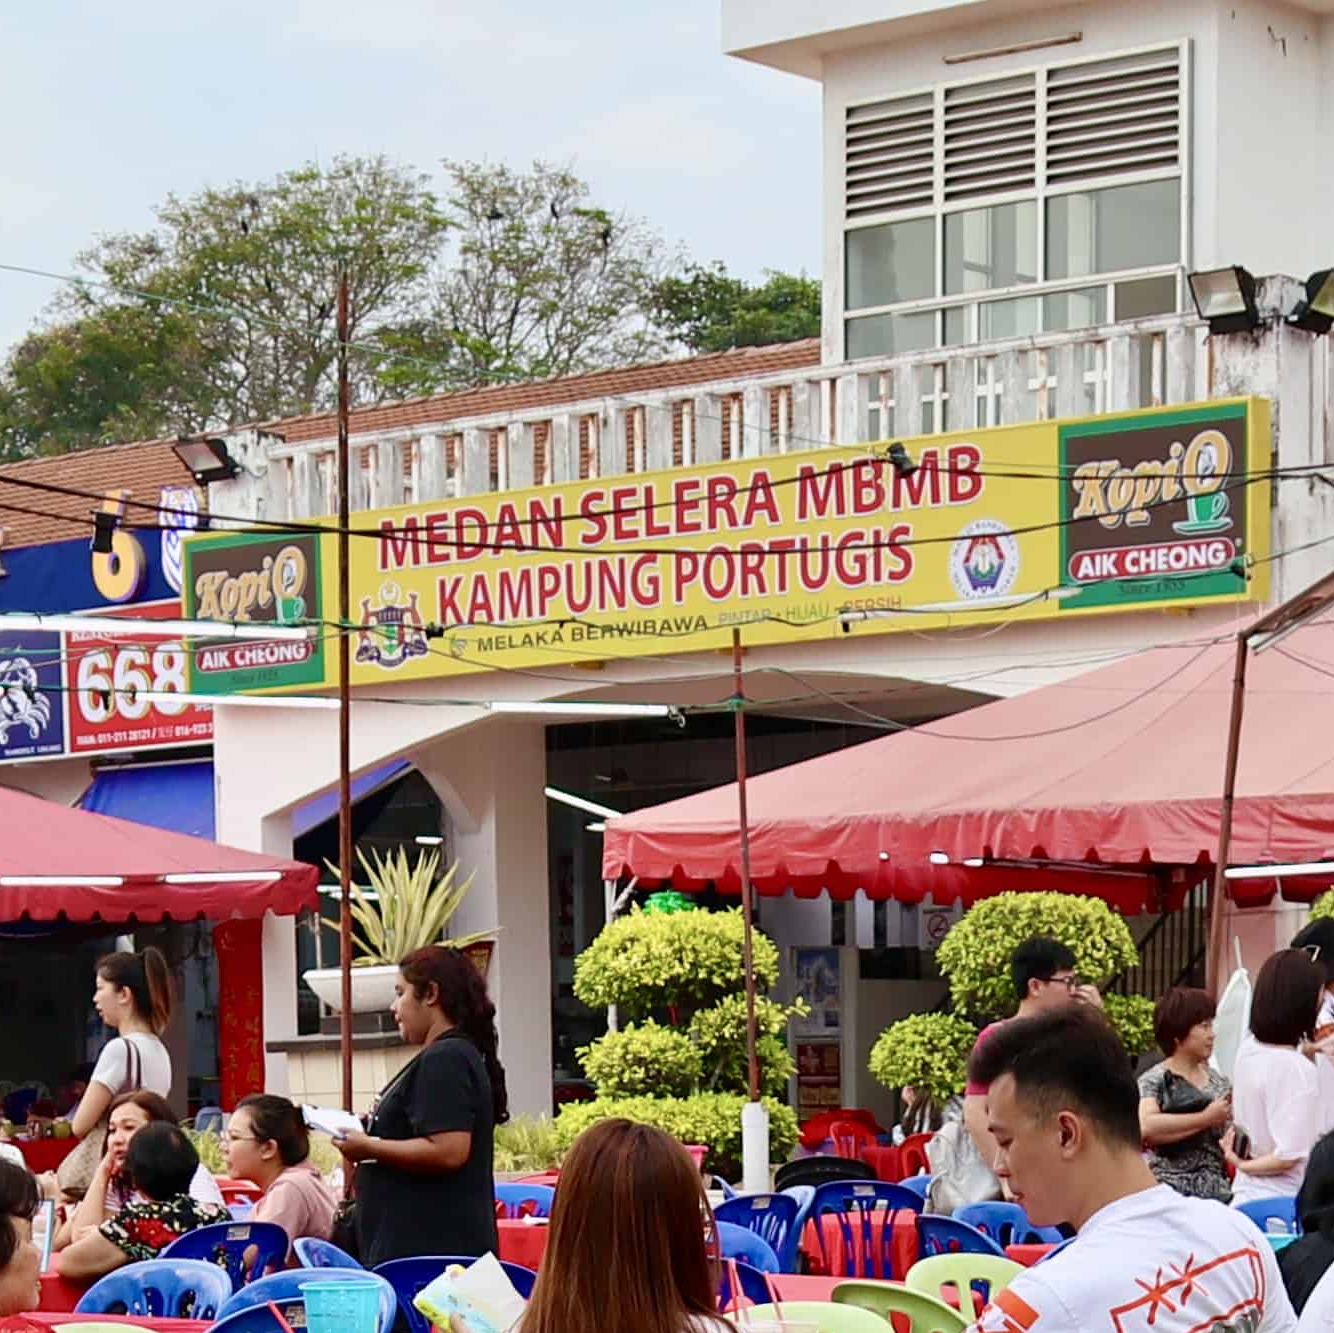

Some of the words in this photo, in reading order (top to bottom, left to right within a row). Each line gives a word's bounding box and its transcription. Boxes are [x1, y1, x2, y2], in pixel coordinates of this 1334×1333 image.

[91, 489, 145, 601] 6
[378, 497, 566, 571] MEDAN
[580, 470, 779, 545] SELERA
[797, 443, 984, 522] MBMB
[438, 550, 661, 627] KAMPUNG
[674, 523, 915, 604] PORTUGIS
[1077, 554, 1119, 579] AIK
[1124, 542, 1227, 575] CHEONG
[202, 651, 231, 670] AIK
[234, 643, 306, 667] CHEONG
[477, 629, 564, 652] MELAKA
[571, 615, 709, 643] BERWIBAWA
[77, 644, 189, 724] 668
